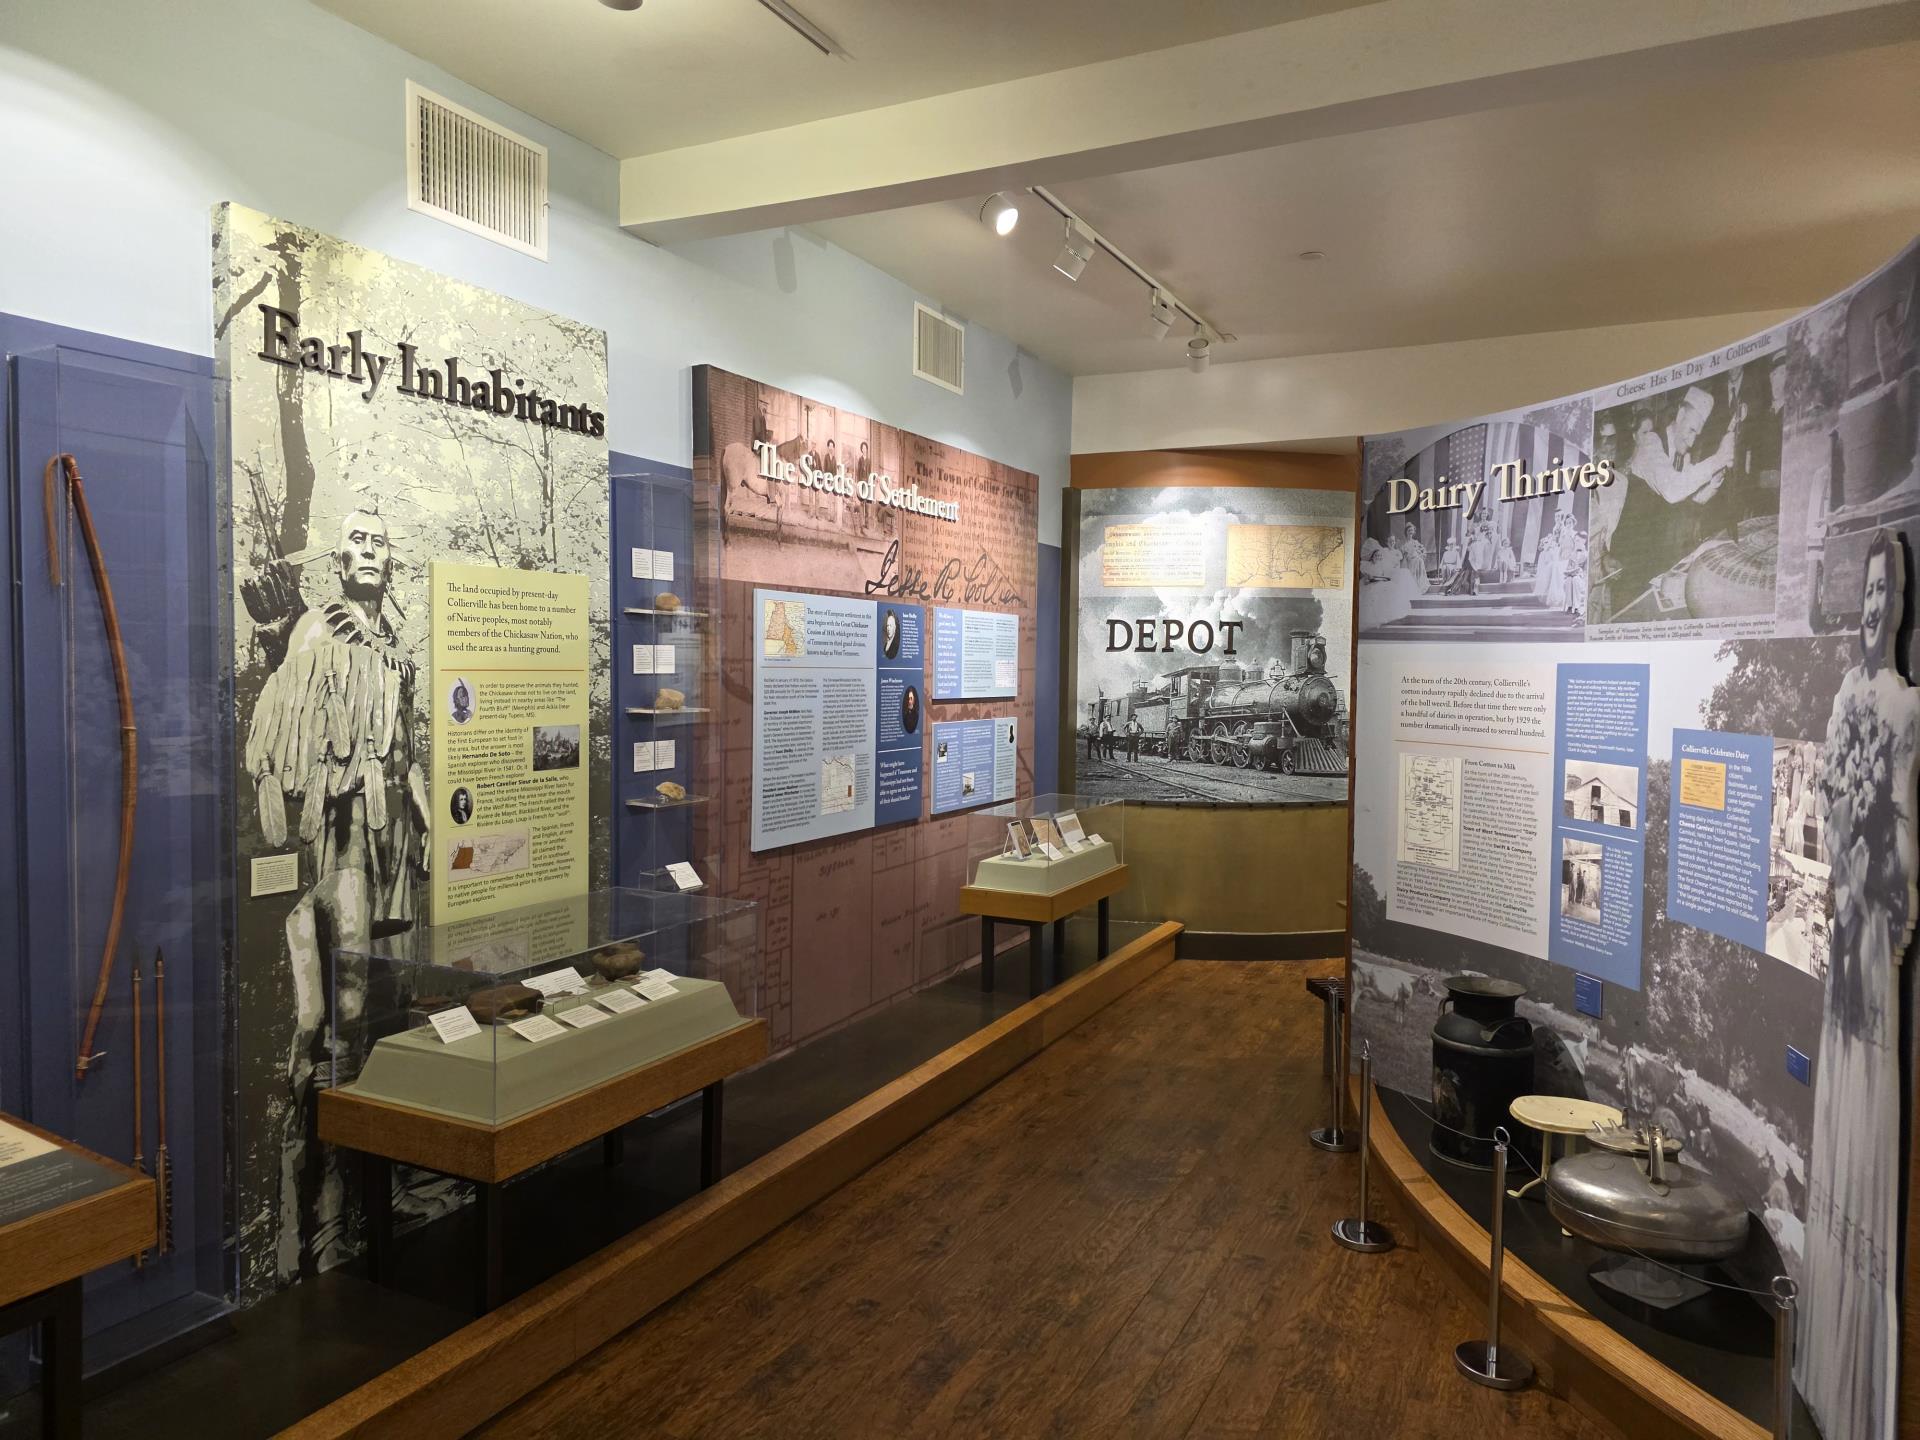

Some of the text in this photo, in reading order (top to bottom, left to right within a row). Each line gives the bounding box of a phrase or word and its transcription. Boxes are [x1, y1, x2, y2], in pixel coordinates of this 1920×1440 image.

[258, 303, 605, 439] Early Inhabitants
[1617, 334, 1771, 398] Cheese Has Its Day At Collierville
[754, 439, 959, 522] The Seeds of Settlement
[915, 461, 933, 478] The
[937, 467, 961, 484] Town
[964, 475, 973, 487] of
[974, 476, 999, 495] Collier
[1386, 458, 1614, 519] Dairy Thrives
[447, 583, 558, 601] The land occupied by present-day
[447, 599, 488, 608] Collierville
[489, 600, 500, 609] has
[502, 601, 518, 610] been
[520, 602, 537, 611] home
[552, 605, 576, 613] number
[447, 614, 456, 622] of
[457, 614, 480, 623] Native
[482, 616, 509, 626] peoples,
[529, 617, 552, 627] notably
[447, 629, 480, 637] members
[482, 629, 489, 638] of
[491, 629, 501, 638] the
[504, 630, 539, 638] Chickasaw
[540, 631, 564, 640] Nation,
[1106, 619, 1243, 655] DEPOT
[509, 644, 534, 654] hunting
[536, 646, 560, 654] ground.
[1401, 676, 1410, 684] At
[1469, 680, 1492, 688] century,
[1494, 679, 1530, 687] Collierville's
[1421, 688, 1445, 697] industry
[1447, 690, 1467, 698] rapidly
[1469, 690, 1494, 698] declined
[1526, 692, 1545, 700] arrival
[1453, 701, 1472, 709] Before
[1534, 705, 1546, 713] only
[1437, 711, 1456, 719] dairies
[1465, 714, 1495, 722] operation,
[1508, 716, 1514, 724] by
[1516, 716, 1530, 724] 1929
[1425, 723, 1461, 732] dramatically
[1462, 725, 1489, 733] increased
[1499, 727, 1519, 735] several
[1520, 728, 1545, 738] hundred.
[1682, 744, 1750, 761] Collierville Celebrates Dairy
[1479, 760, 1496, 768] Cotton
